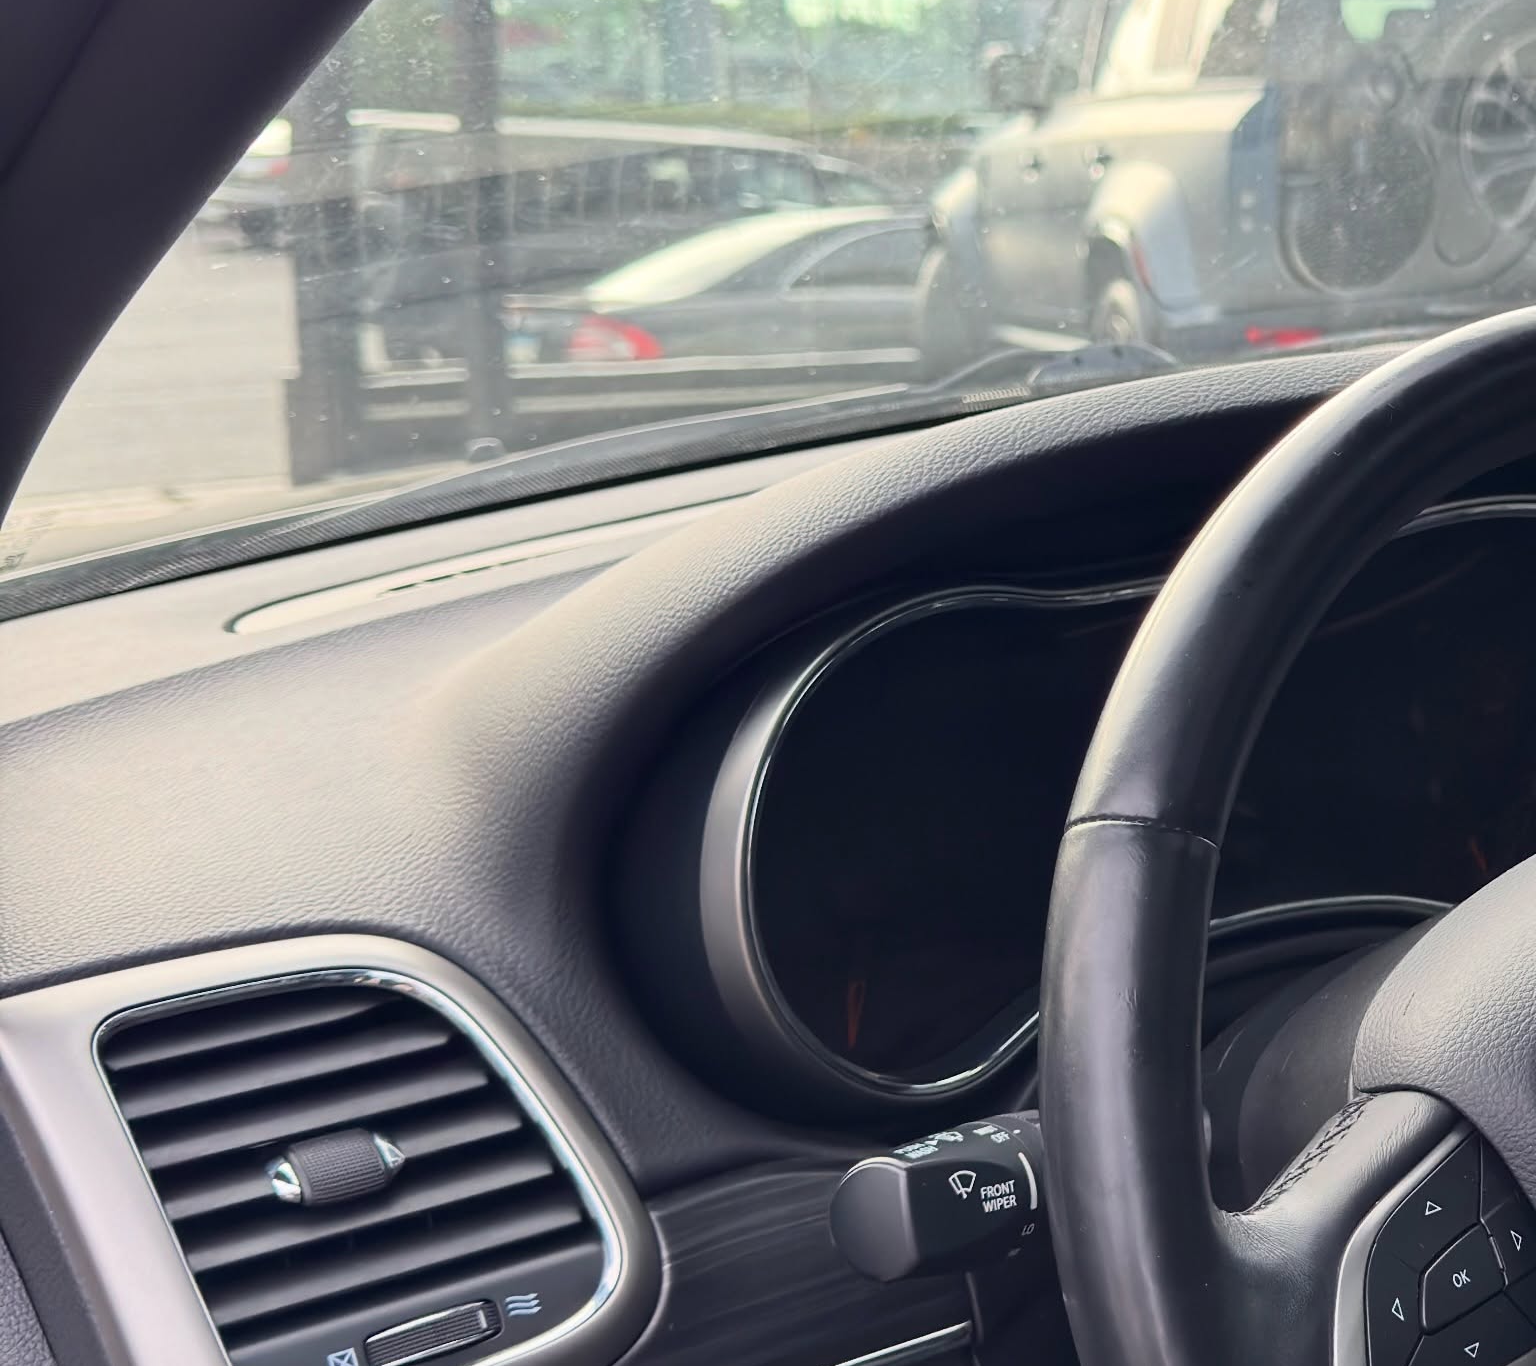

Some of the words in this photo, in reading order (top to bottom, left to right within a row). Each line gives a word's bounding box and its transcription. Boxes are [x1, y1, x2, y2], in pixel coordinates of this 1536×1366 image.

[980, 1179, 1016, 1200] FRONT
[982, 1194, 1018, 1214] WIPER
[1021, 1223, 1035, 1236] LO
[1452, 1269, 1471, 1288] OK
